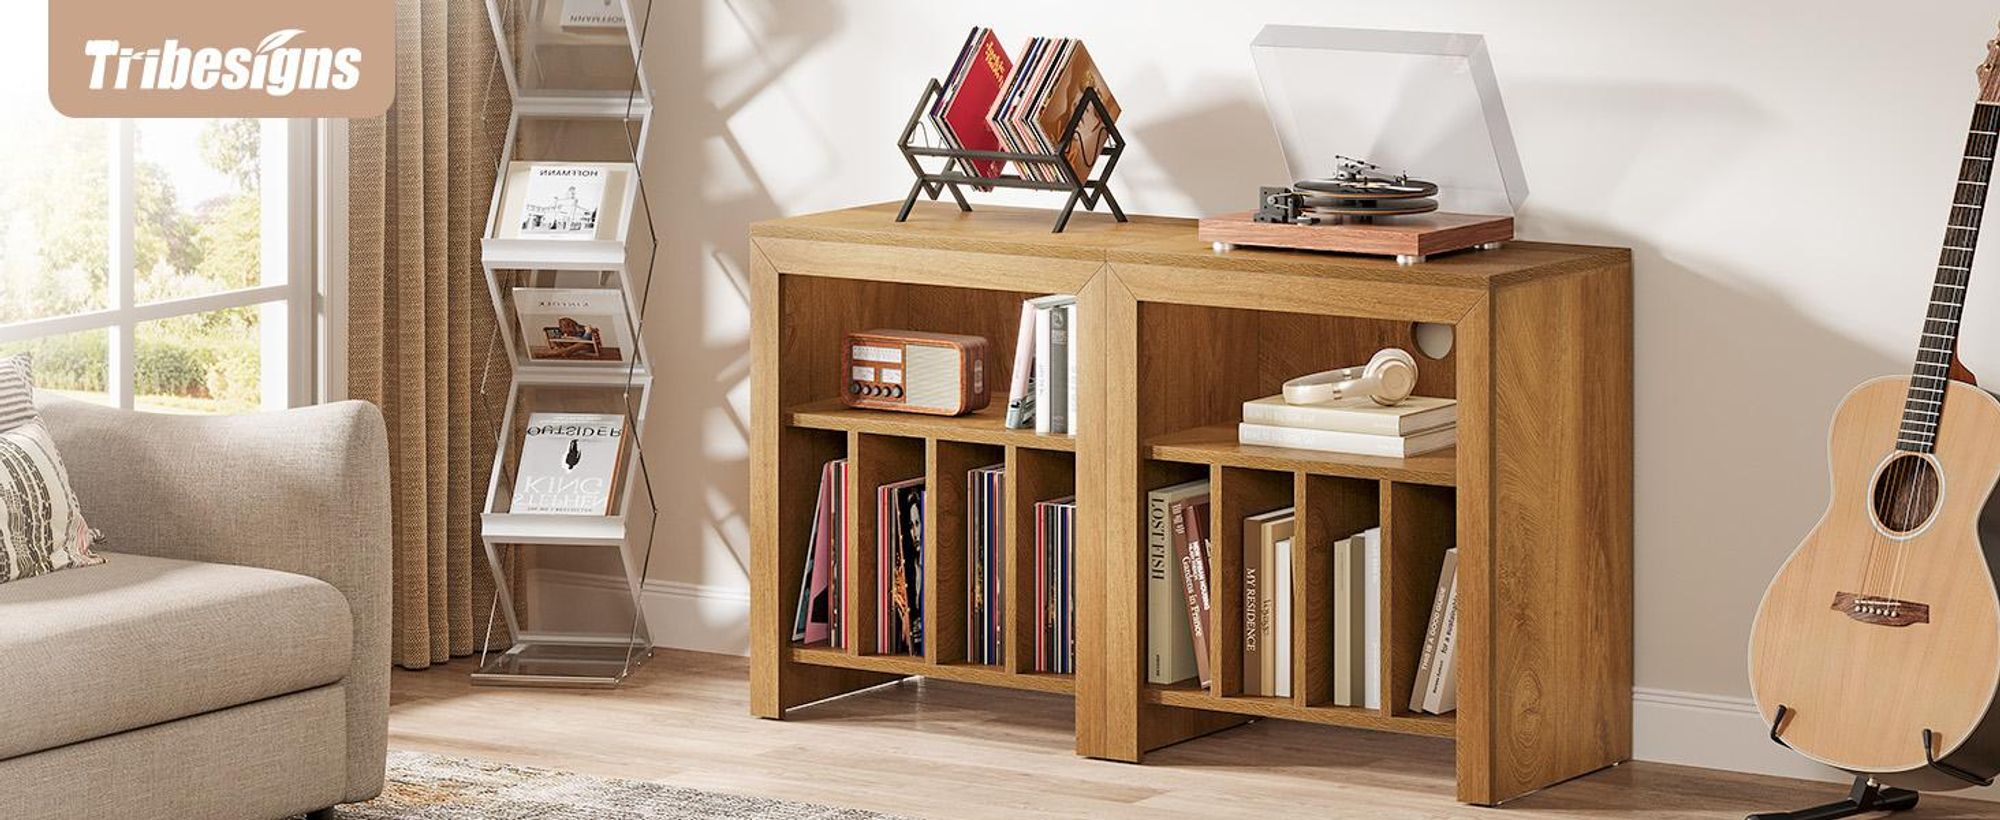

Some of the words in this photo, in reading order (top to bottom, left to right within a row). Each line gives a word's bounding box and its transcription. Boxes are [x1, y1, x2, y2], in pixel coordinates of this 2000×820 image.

[1151, 498, 1165, 541] LOST
[1151, 544, 1165, 579] FISH
[1182, 556, 1195, 595] Gardens
[1246, 567, 1257, 588] MY
[1188, 593, 1198, 606] in
[1192, 605, 1202, 637] France
[1246, 587, 1257, 653] RESIDENCE
[1430, 610, 1441, 637] GOOD
[1441, 642, 1449, 655] for
